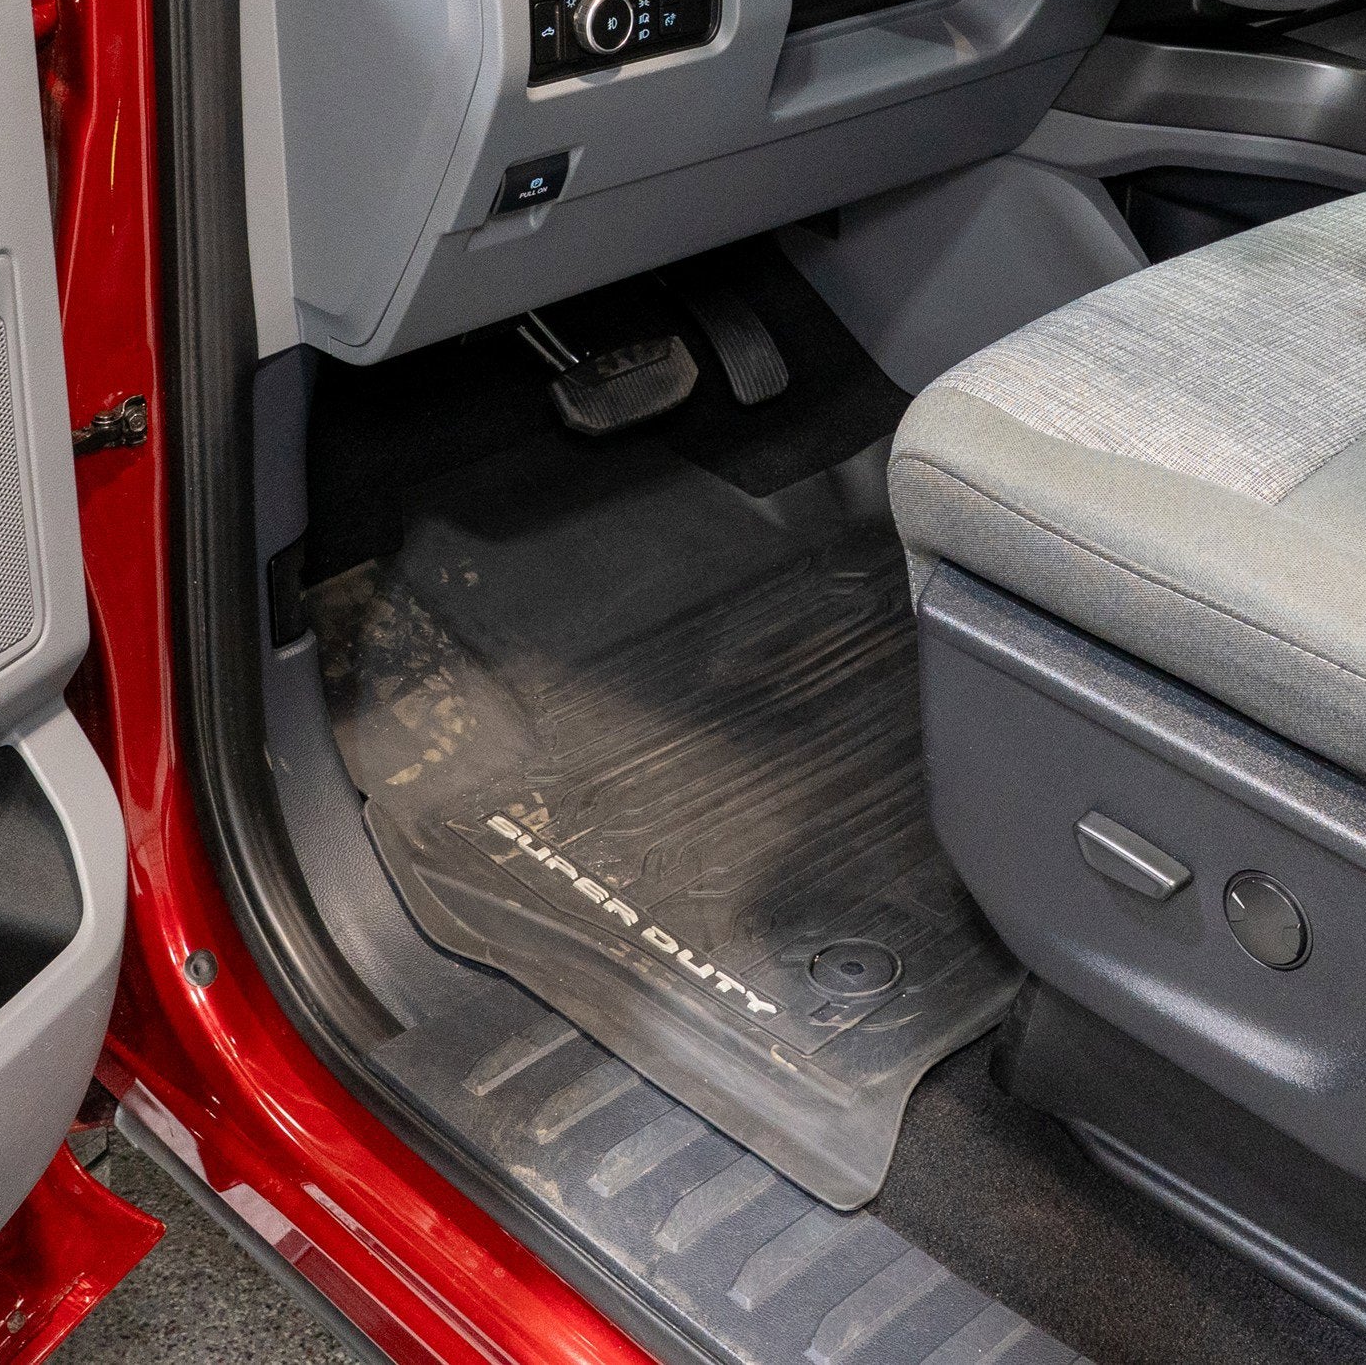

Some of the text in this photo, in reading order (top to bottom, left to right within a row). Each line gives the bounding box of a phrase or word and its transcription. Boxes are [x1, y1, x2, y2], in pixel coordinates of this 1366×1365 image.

[519, 186, 548, 199] PULL ON
[487, 815, 778, 1015] SUPER DUTY
